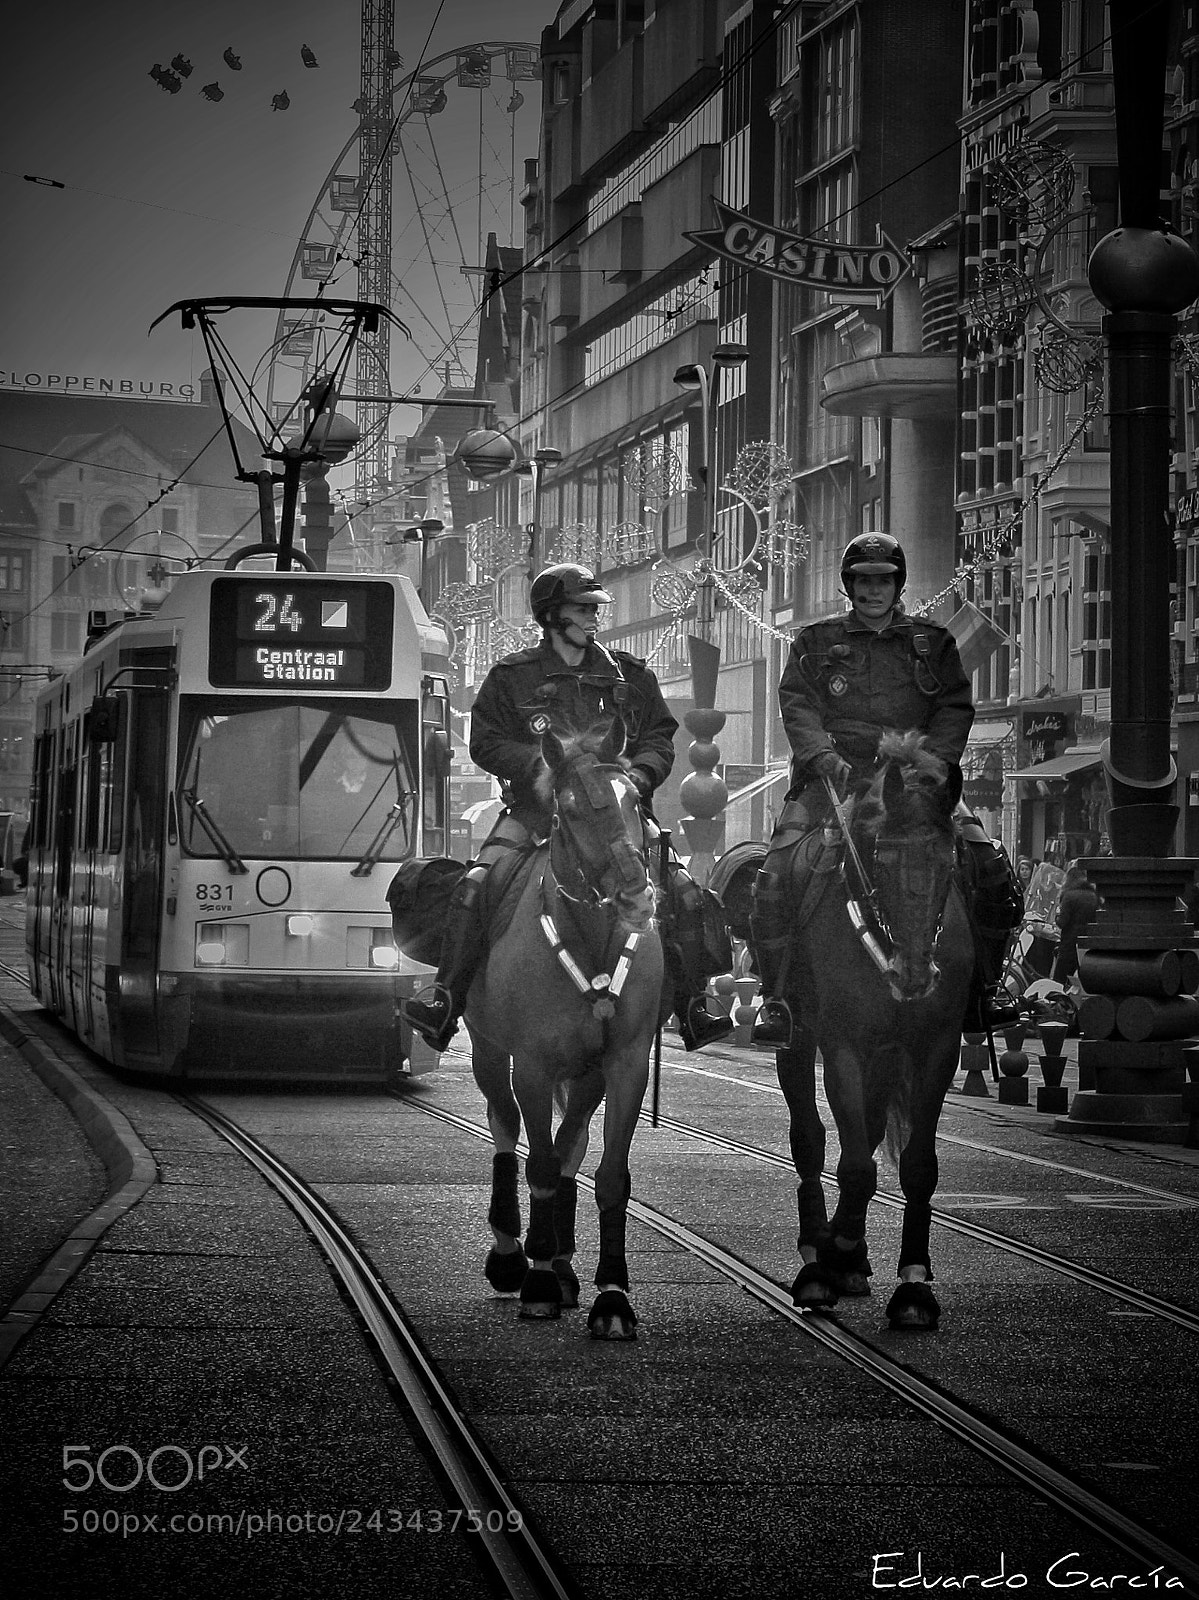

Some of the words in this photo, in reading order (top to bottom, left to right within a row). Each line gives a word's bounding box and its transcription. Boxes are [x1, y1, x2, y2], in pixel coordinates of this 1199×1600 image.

[724, 221, 901, 284] CASINO
[255, 593, 303, 632] 24
[256, 648, 345, 667] Centraal
[263, 664, 336, 682] Station
[196, 884, 235, 902] 831
